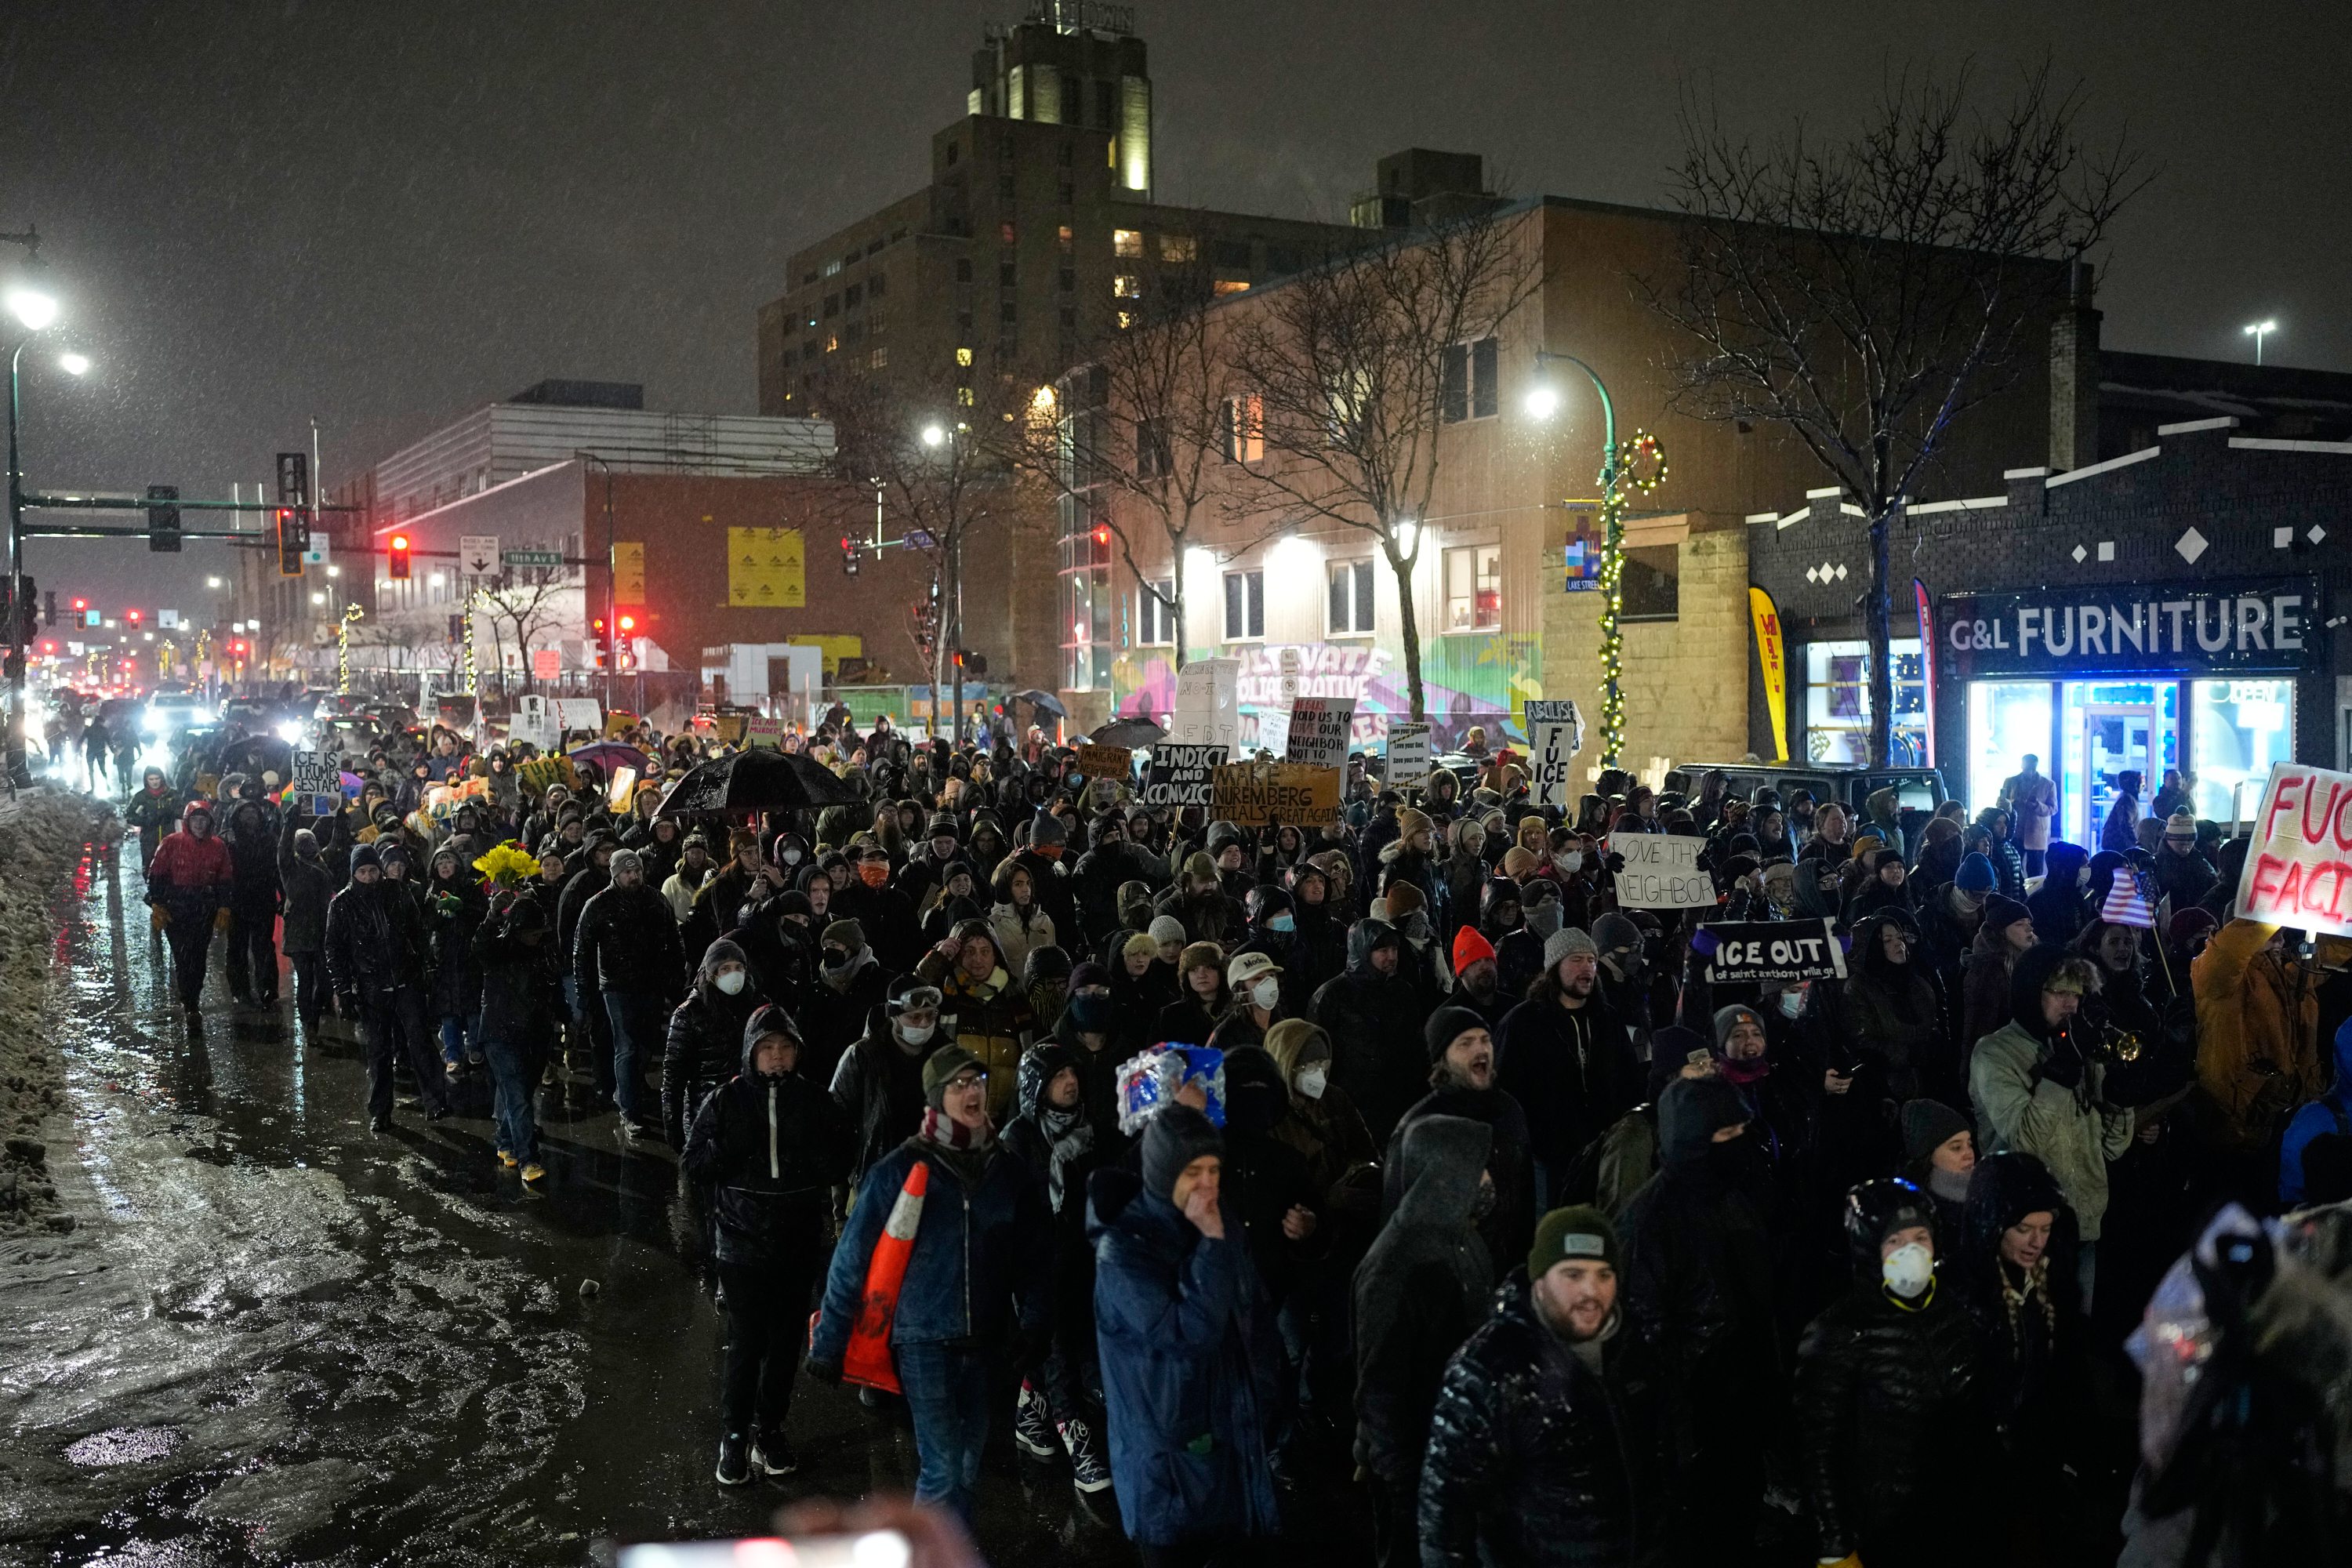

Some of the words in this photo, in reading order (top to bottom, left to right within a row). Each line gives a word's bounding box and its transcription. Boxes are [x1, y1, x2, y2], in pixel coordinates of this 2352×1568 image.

[511, 554, 531, 562] 11th
[533, 554, 546, 562] Av
[1567, 580, 1581, 590] LAKE
[1950, 618, 2009, 651] G&L
[2019, 595, 2303, 657] FURNITURE
[2231, 682, 2276, 704] OPEN
[1293, 699, 1327, 711] JESUS
[1526, 701, 1576, 720] ABOLISH
[1293, 710, 1316, 721] TOLD
[1318, 712, 1333, 722] US
[1337, 710, 1352, 723] TO
[1290, 722, 1316, 735] LOVE
[1319, 724, 1341, 736] OUR
[1288, 735, 1344, 751] NEIGHBOR
[294, 751, 318, 766] ICE
[324, 752, 338, 767] IS
[1079, 750, 1129, 765] IMMIGRANT
[1155, 746, 1229, 770] INDICT
[1288, 747, 1308, 759] NOT
[1313, 750, 1327, 759] TO
[1171, 769, 1205, 782] AND
[1215, 764, 1280, 786] MAKE
[293, 777, 341, 793] GESTAPO
[1213, 786, 1313, 807] NUREMBERG
[1214, 805, 1268, 821] TRIALS
[1269, 806, 1306, 823] GREAT
[1307, 806, 1339, 823] AGAIN
[1668, 842, 1703, 864] THY
[1614, 875, 1716, 904] NEIGHBOR
[1715, 941, 1764, 966] ICE
[1770, 938, 1823, 965] OUT
[1716, 970, 1728, 979] of
[1730, 968, 1757, 979] saint
[1759, 968, 1800, 981] anthony
